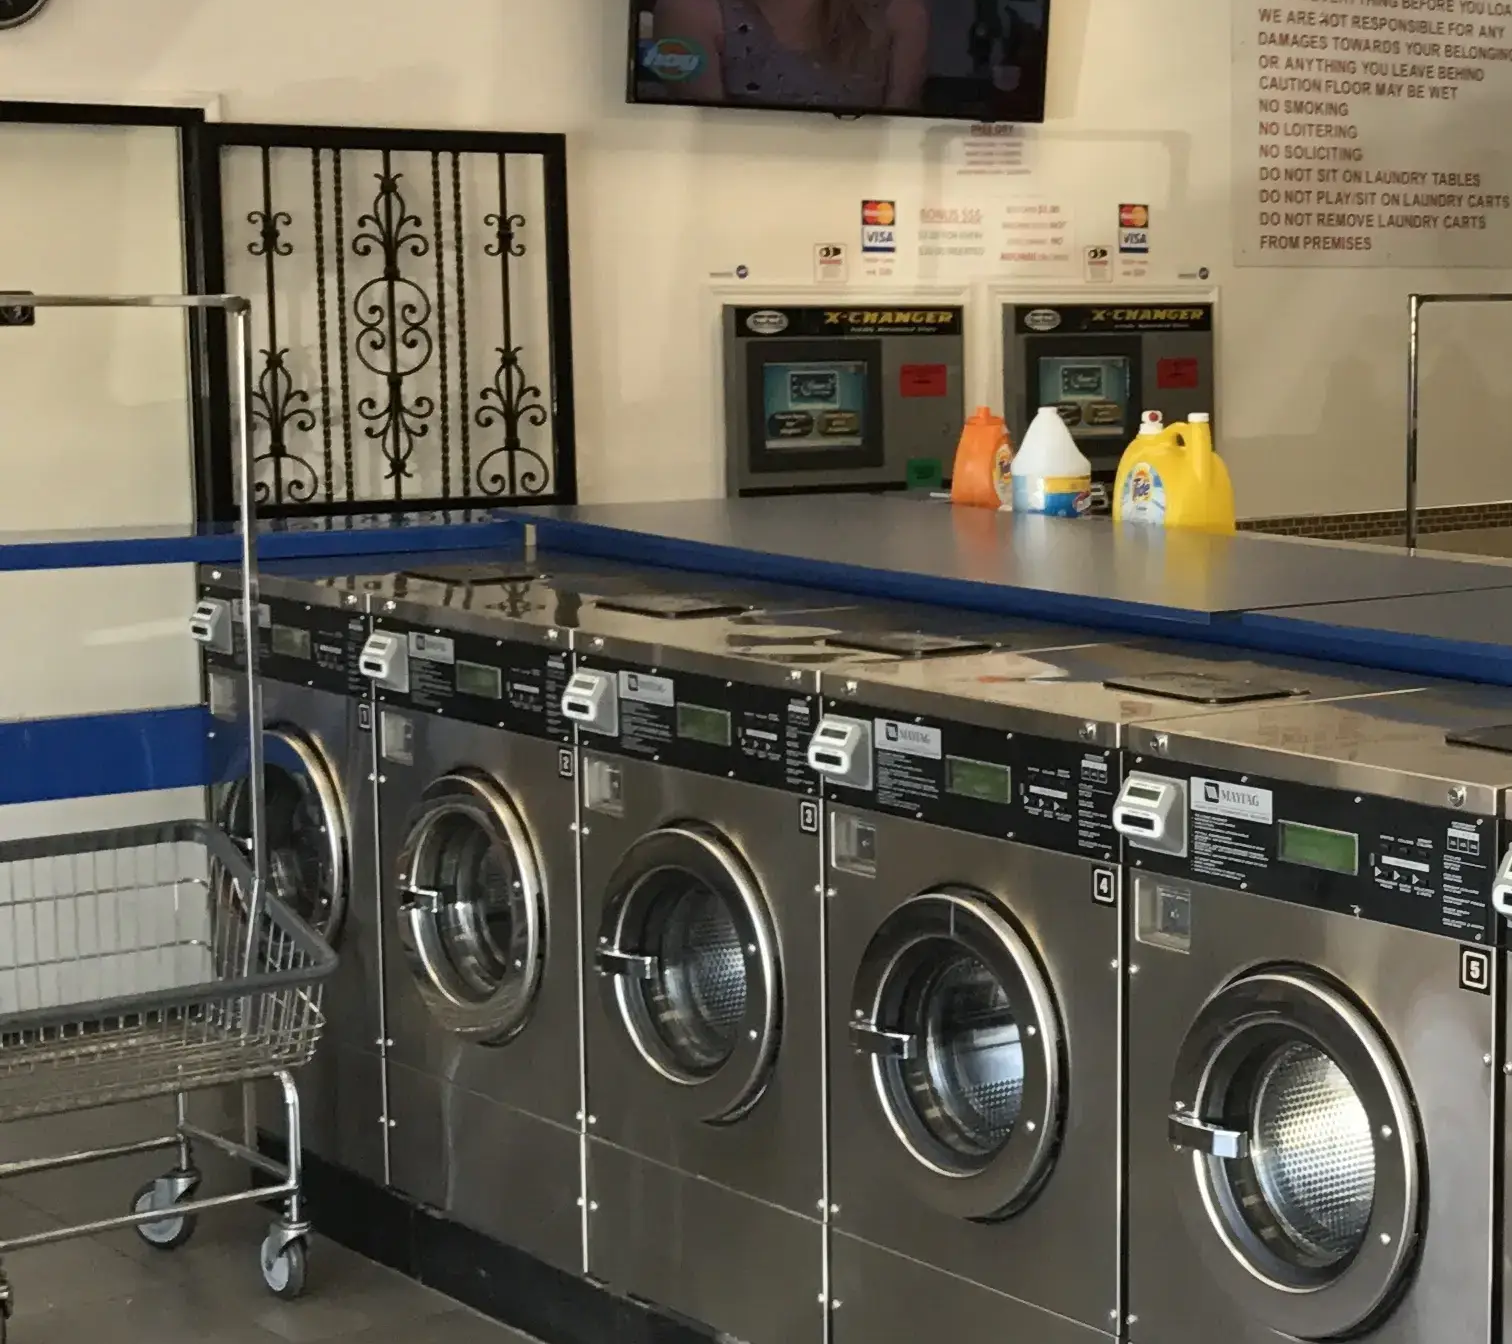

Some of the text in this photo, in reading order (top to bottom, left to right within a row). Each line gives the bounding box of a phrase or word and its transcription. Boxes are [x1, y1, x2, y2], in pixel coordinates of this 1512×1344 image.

[1459, 0, 1484, 15] YOU
[1258, 8, 1282, 23] WE
[1286, 10, 1316, 26] ARE
[1351, 15, 1445, 36] RESPONSIBLE
[1448, 22, 1474, 36] FOR
[1478, 25, 1505, 39] ANY
[1258, 31, 1328, 50] DAMAGES
[1331, 36, 1400, 55] TOWARDS
[1405, 41, 1440, 57] YOUR
[1259, 54, 1485, 82] OR ANYTHING YOU LEAVE BEHIND
[1259, 75, 1459, 100] CAUTION FLOOR MAY BE WET
[1259, 98, 1349, 117] NO SMOKING
[1259, 121, 1358, 140] NO LOITERING
[1259, 144, 1364, 162] NO SOLICITING
[1260, 166, 1481, 187] DO NOT SIT ON LAUNDRY TABLES
[1260, 189, 1281, 204] DO
[1284, 190, 1313, 205] NOT
[1380, 192, 1400, 207] ON
[1403, 193, 1463, 207] LAUNDRY
[1467, 194, 1511, 209] CARTS
[1260, 212, 1486, 230] DO NOT REMOVE LAUNDRY CARTS
[866, 230, 894, 244] VISA
[1123, 232, 1147, 245] VISA
[1260, 235, 1372, 251] FROM PREMISES
[823, 311, 953, 325] X-CHANGER
[1091, 309, 1204, 321] X-CHANGER
[562, 756, 569, 769] 2
[805, 808, 813, 824] 3
[1099, 877, 1109, 894] 4
[1469, 960, 1480, 979] 5
